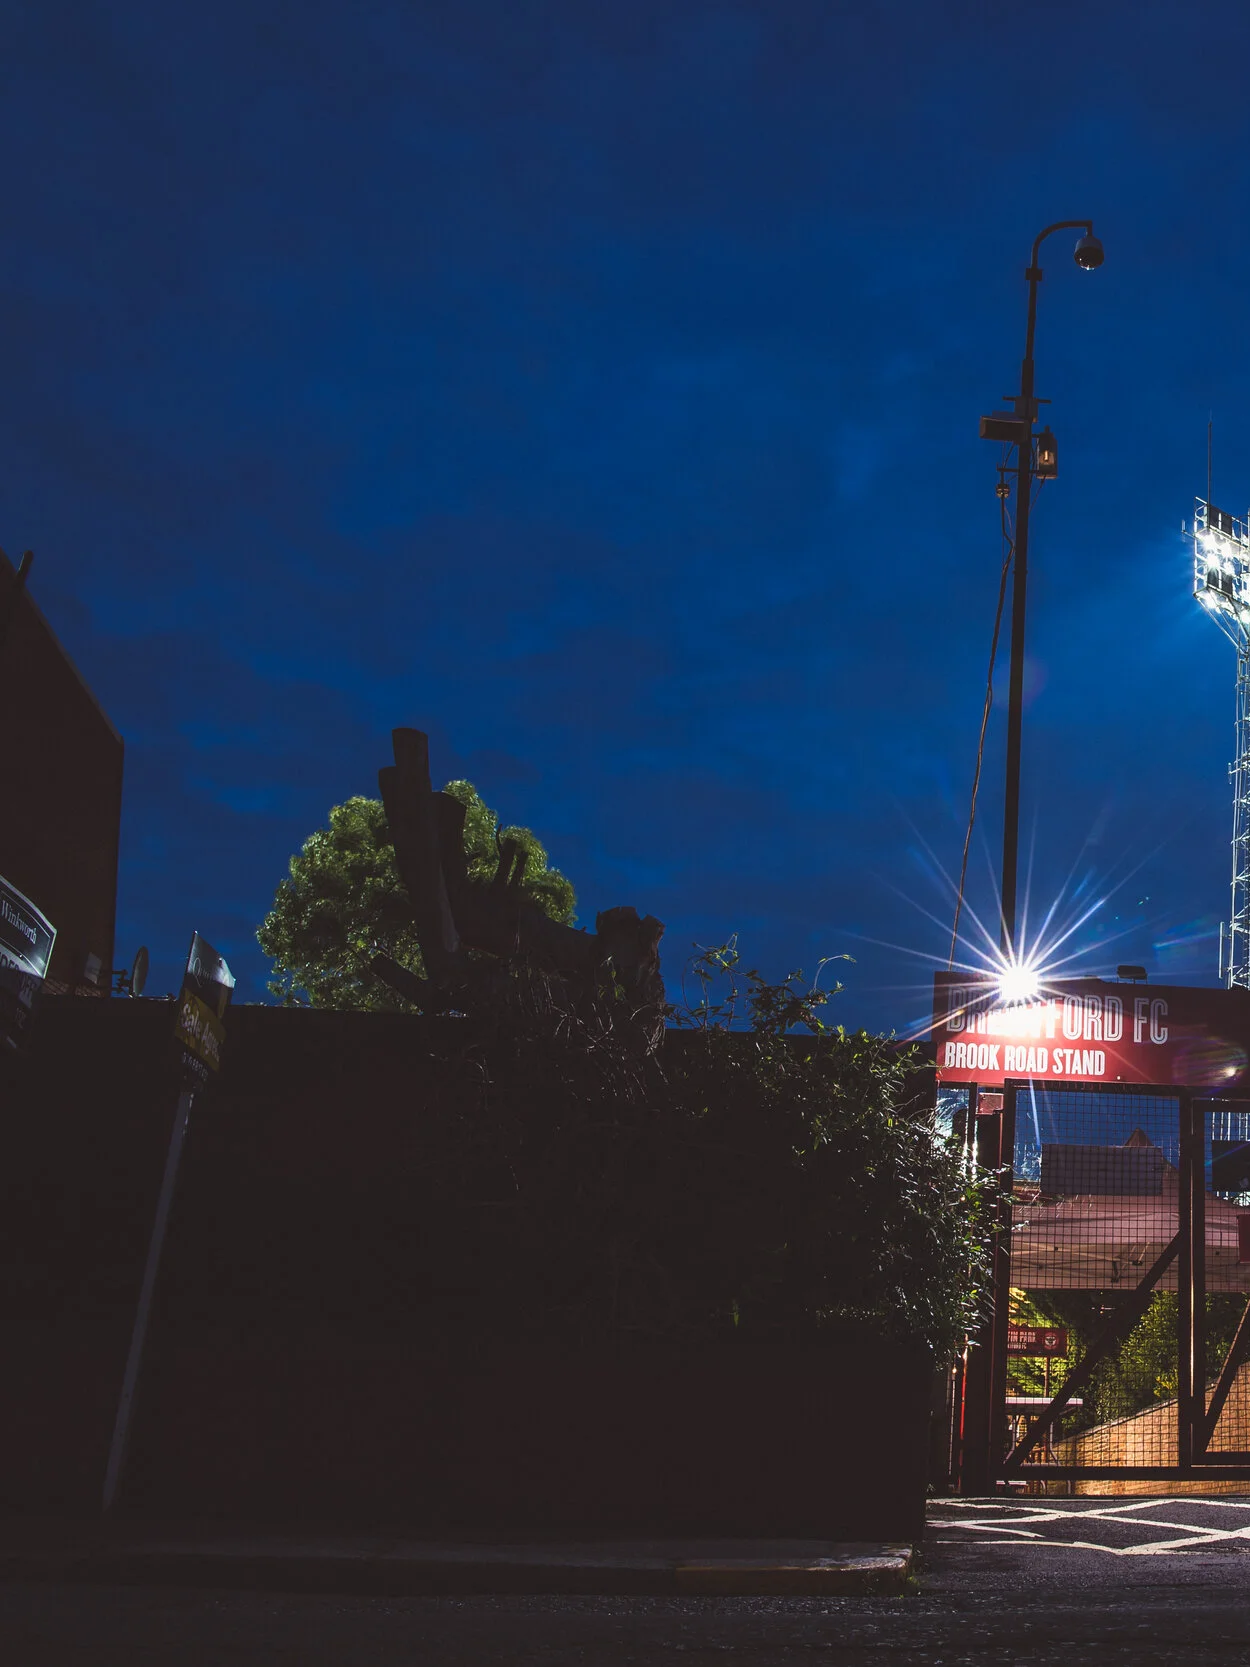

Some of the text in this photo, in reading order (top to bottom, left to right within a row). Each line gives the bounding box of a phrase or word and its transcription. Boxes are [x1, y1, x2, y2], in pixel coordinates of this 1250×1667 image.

[1, 898, 37, 945] Winkworth
[181, 1002, 203, 1041] Sale
[1133, 998, 1169, 1045] FC
[944, 1041, 1106, 1076] BROOK ROAD STAND
